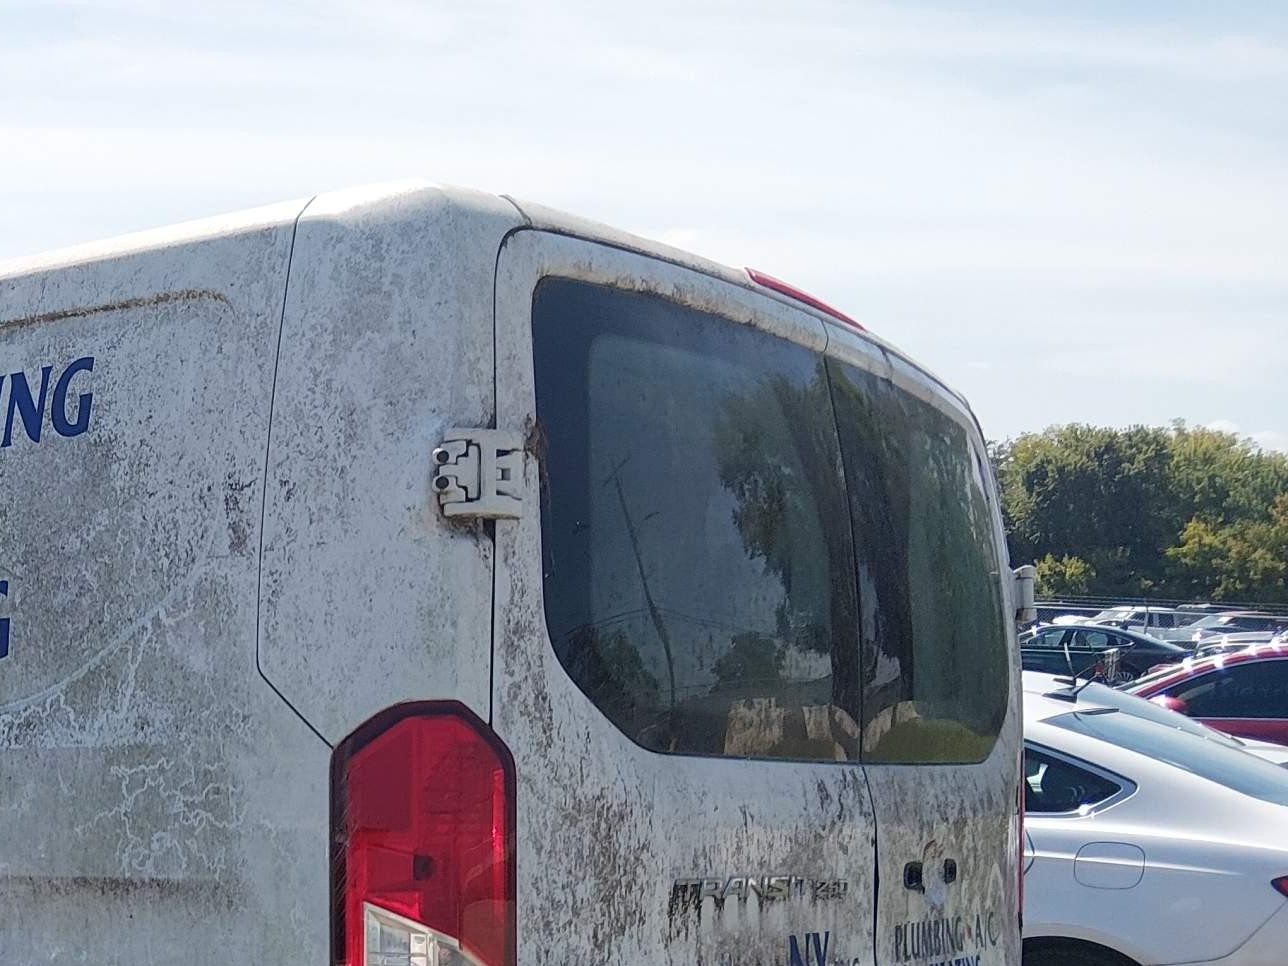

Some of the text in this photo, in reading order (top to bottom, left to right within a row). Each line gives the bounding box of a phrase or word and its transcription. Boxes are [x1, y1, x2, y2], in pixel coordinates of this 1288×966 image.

[673, 875, 806, 901] TRANSIT
[895, 911, 1000, 961] PLUMBING A/C
